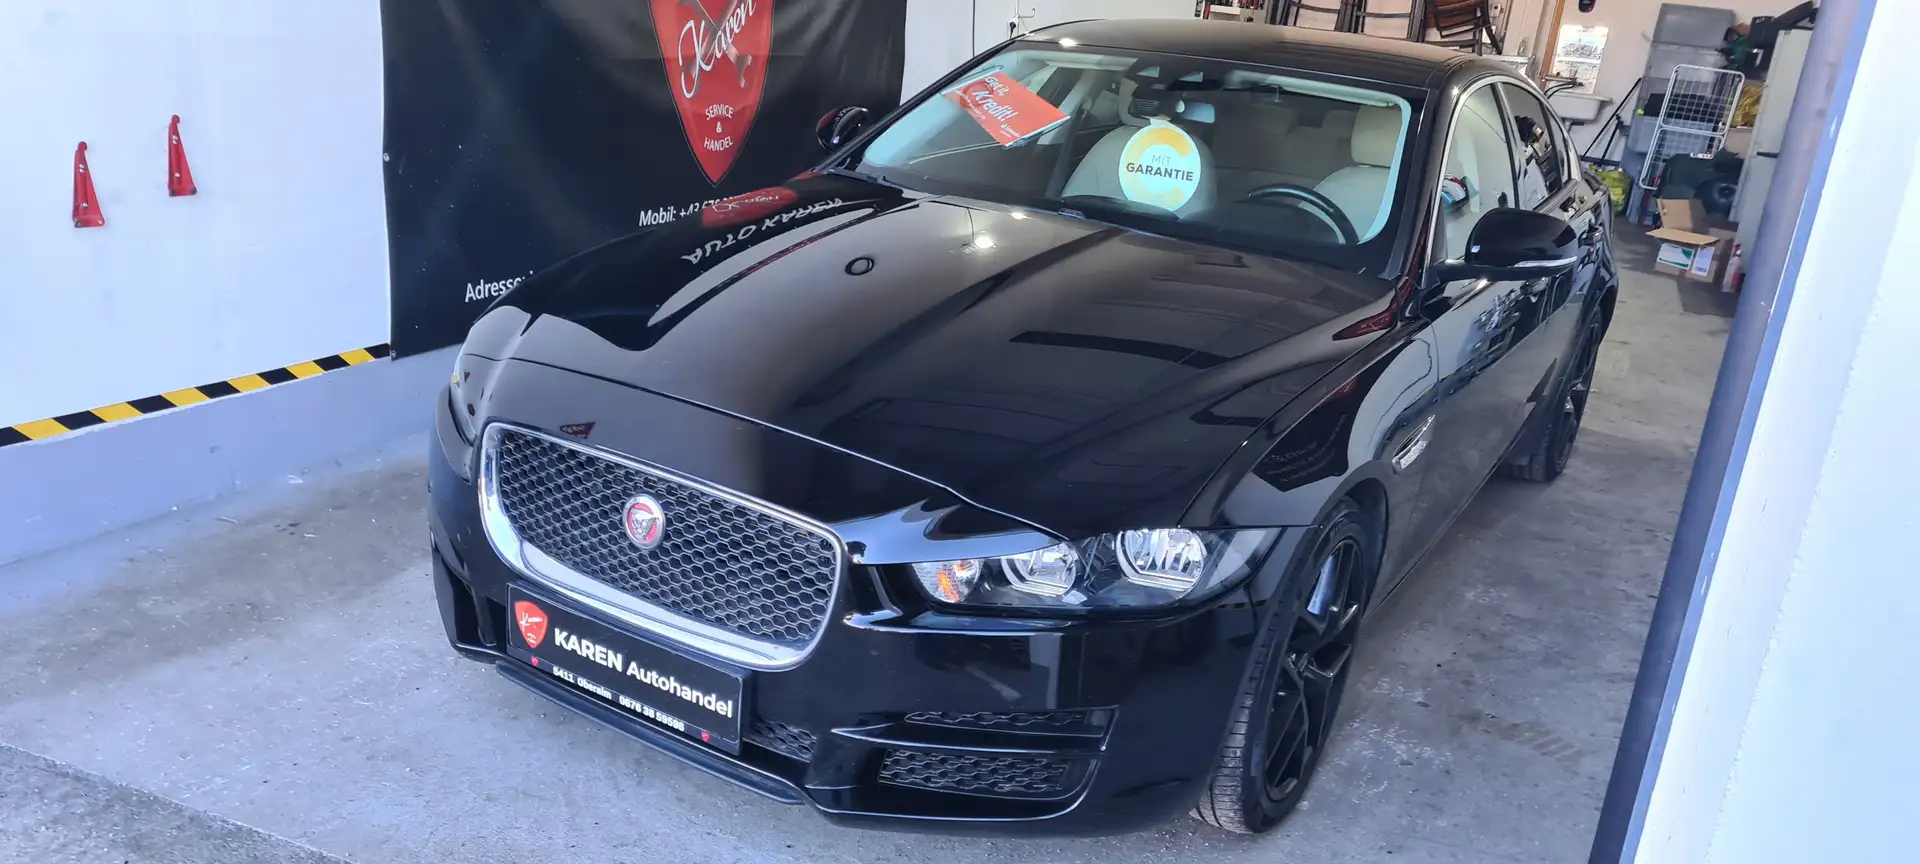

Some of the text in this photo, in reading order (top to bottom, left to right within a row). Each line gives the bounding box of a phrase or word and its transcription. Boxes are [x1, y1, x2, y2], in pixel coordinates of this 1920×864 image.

[678, 0, 757, 98] Karen
[984, 76, 1001, 93] Get
[705, 104, 734, 121] SERVICE
[972, 91, 1020, 122] Kredit!
[716, 121, 723, 133] &
[703, 136, 734, 152] HANDEL
[1151, 154, 1171, 165] MIT
[1125, 162, 1195, 182] GARANTIE
[638, 208, 677, 227] Mobil:
[552, 665, 575, 684] 5411
[577, 677, 612, 700] Oberalm
[553, 627, 734, 719] KAREN Autohandel
